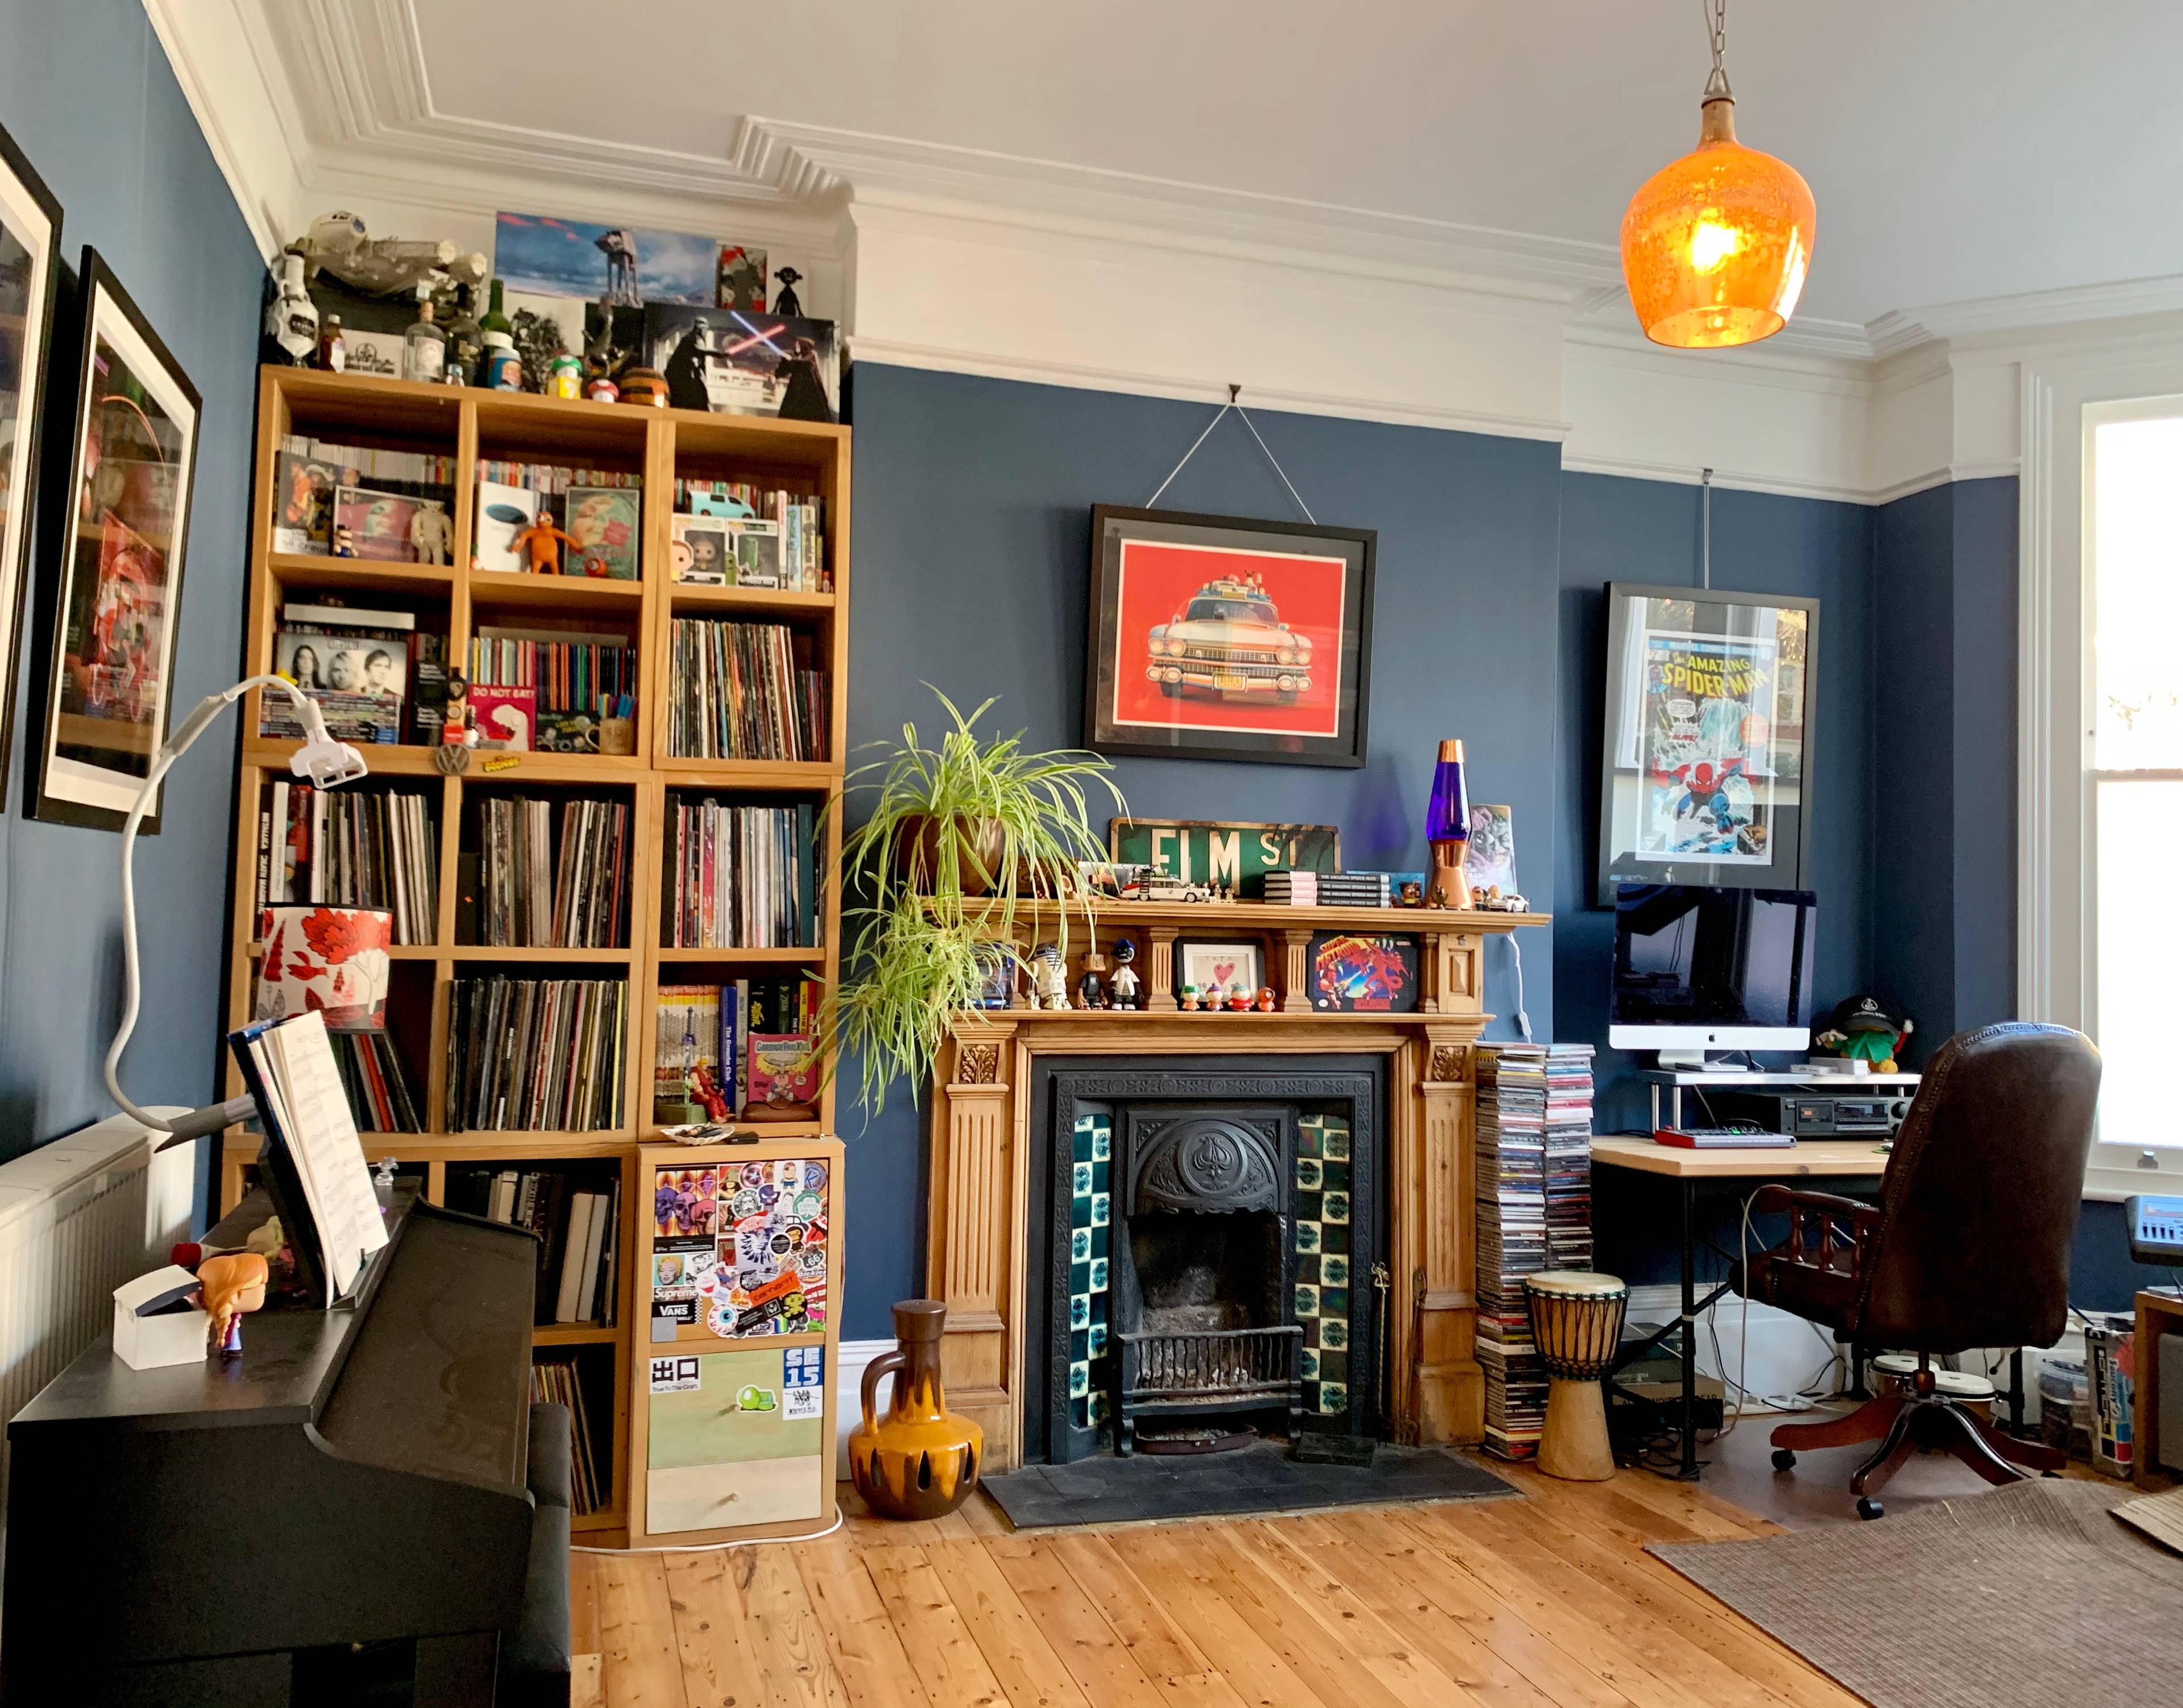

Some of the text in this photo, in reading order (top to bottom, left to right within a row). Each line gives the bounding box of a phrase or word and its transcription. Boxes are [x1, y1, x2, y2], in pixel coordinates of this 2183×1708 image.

[1687, 655, 1751, 673] AMAZING
[473, 686, 488, 697] DO
[490, 688, 511, 698] NOT
[1319, 935, 1346, 954] SUPER
[807, 1254, 821, 1267] 66
[654, 1287, 698, 1300] Supreme
[753, 1276, 794, 1302] carhartt
[659, 1304, 689, 1316] VANS
[786, 1347, 820, 1367] SE
[652, 1358, 699, 1383] 出口
[786, 1366, 820, 1387] 15
[2109, 1359, 2119, 1404] Saucony
